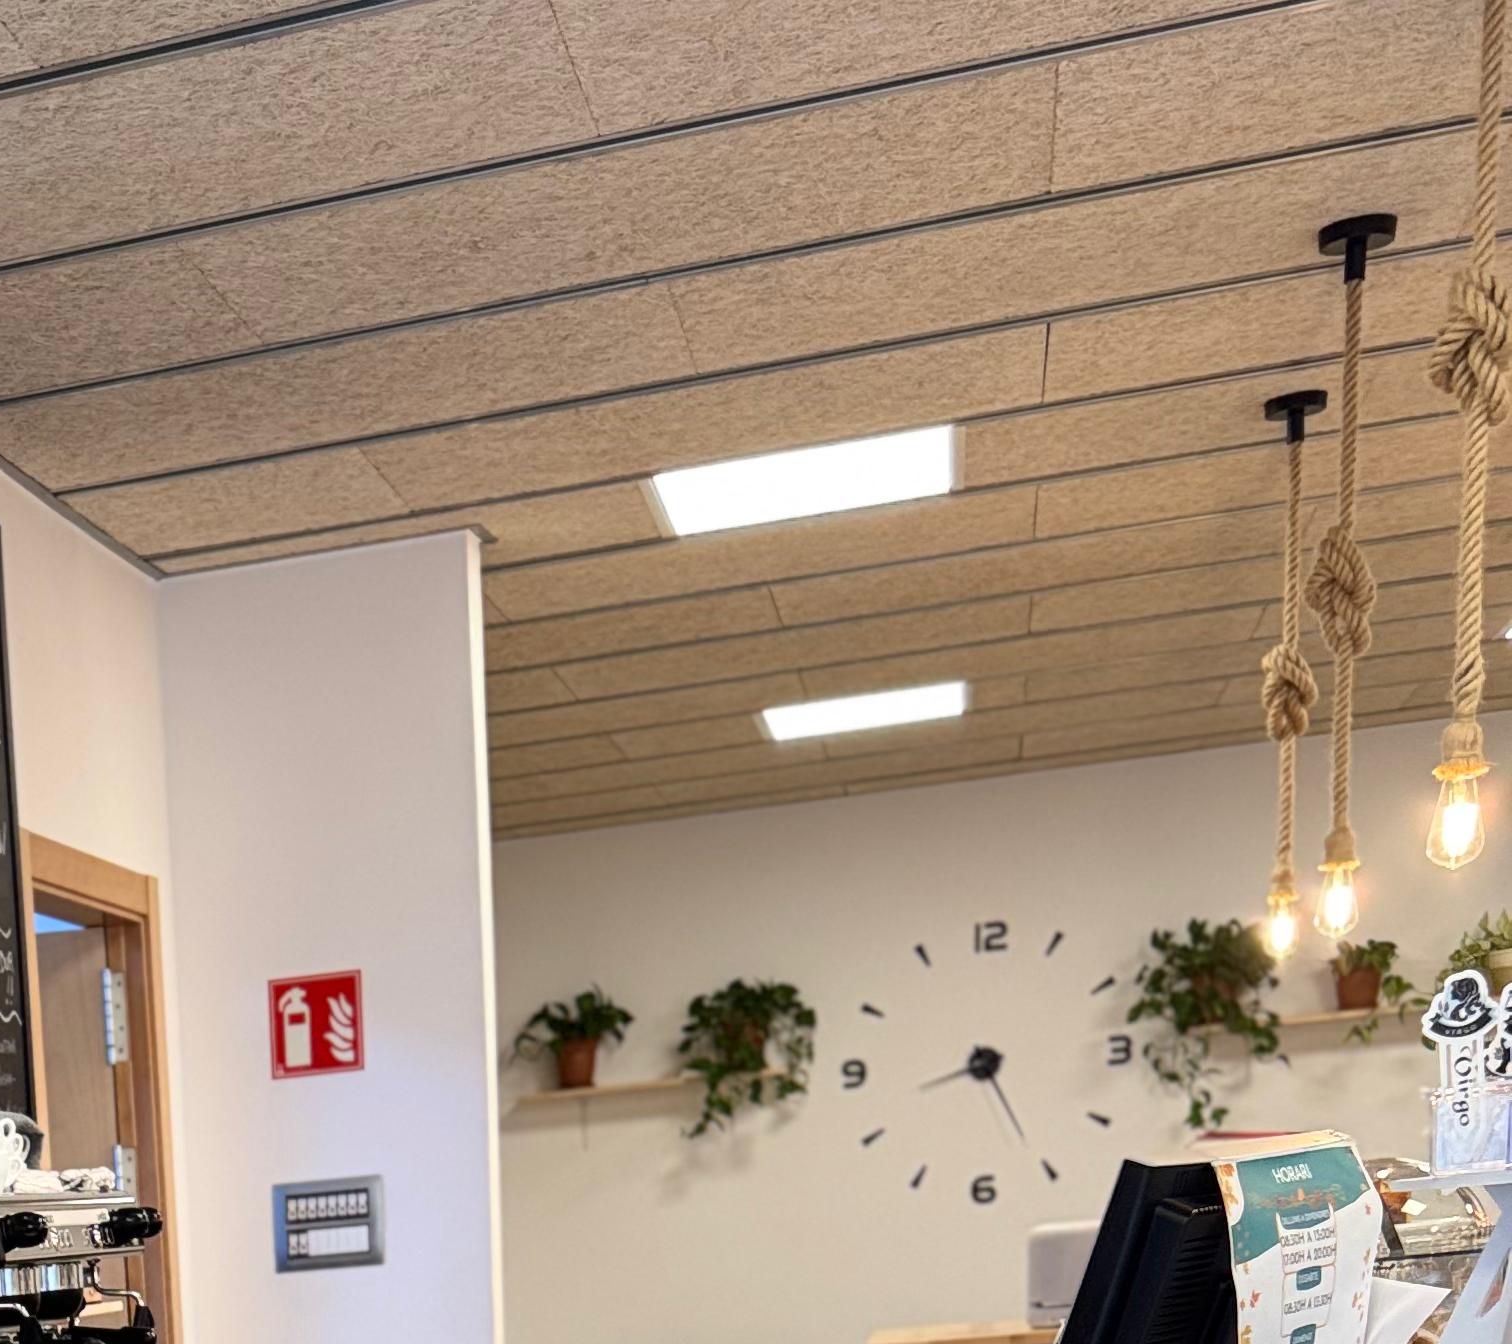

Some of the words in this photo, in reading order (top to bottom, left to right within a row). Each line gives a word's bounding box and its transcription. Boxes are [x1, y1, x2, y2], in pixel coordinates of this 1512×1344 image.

[974, 920, 1009, 954] 12
[841, 1059, 867, 1090] 9
[1106, 1035, 1133, 1066] 3
[1272, 1163, 1313, 1184] HORARI
[971, 1175, 997, 1204] 6
